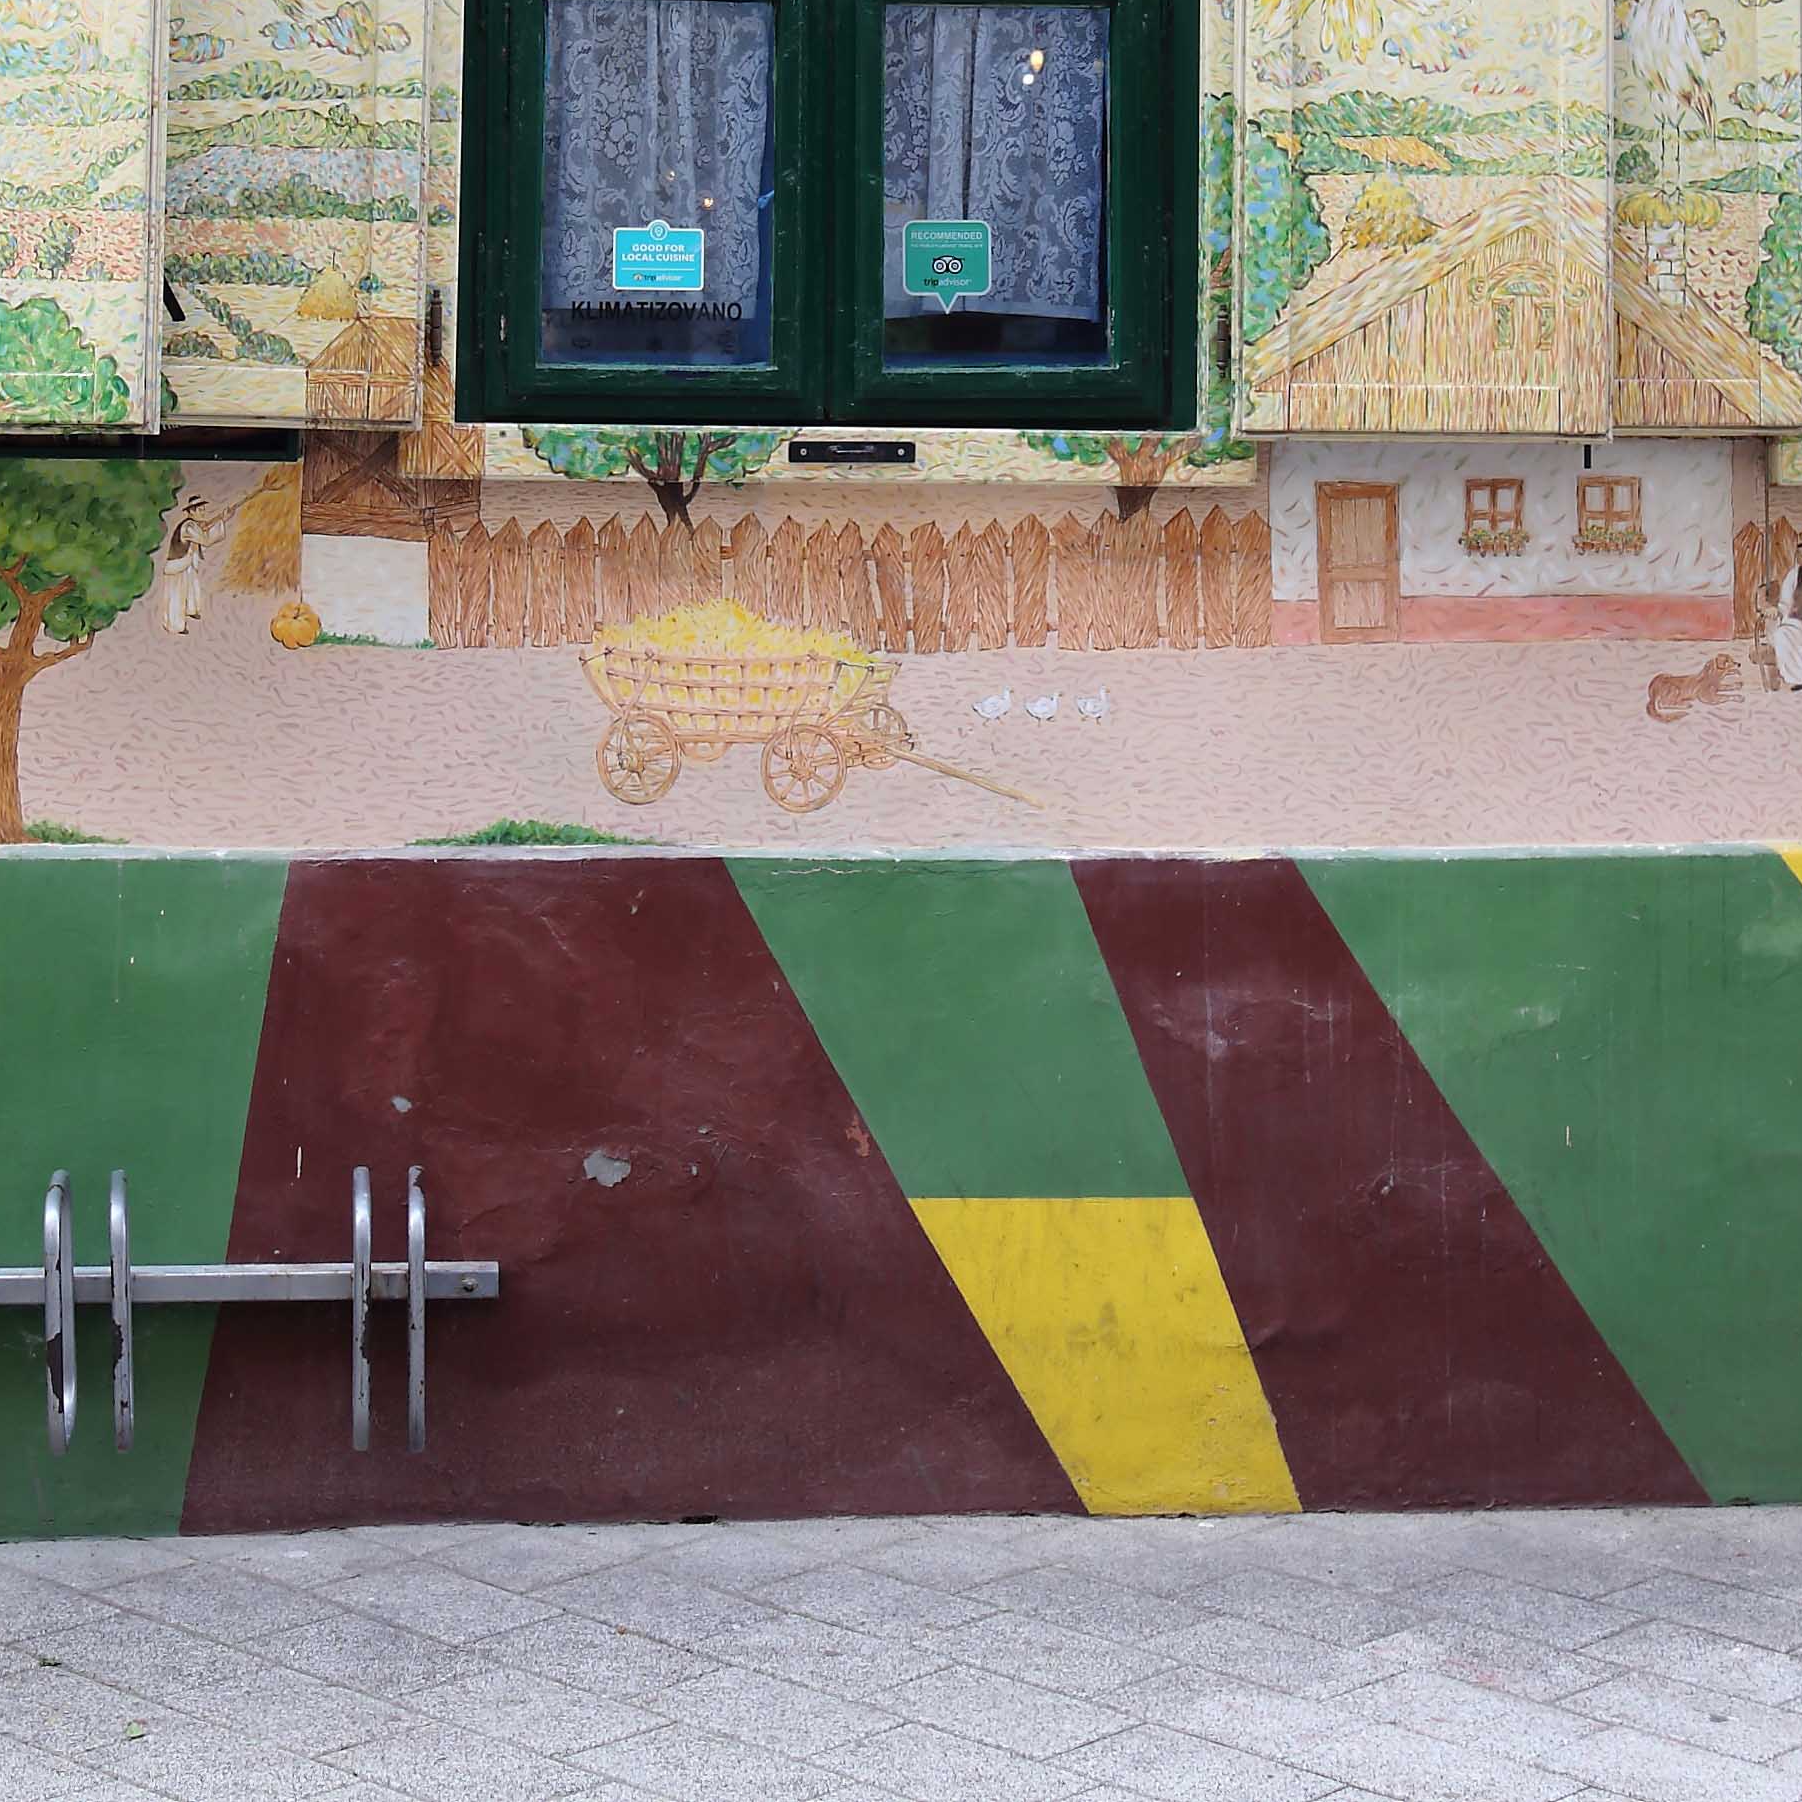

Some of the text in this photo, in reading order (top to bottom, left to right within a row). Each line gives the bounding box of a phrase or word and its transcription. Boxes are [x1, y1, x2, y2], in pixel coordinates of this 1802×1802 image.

[910, 231, 983, 240] RECOMMENDED
[631, 244, 685, 253] GOOD FOR
[621, 253, 695, 262] LOCAL CUISINE
[923, 278, 971, 288] tripadvisor
[571, 301, 742, 320] KLIMATIZOVANO
